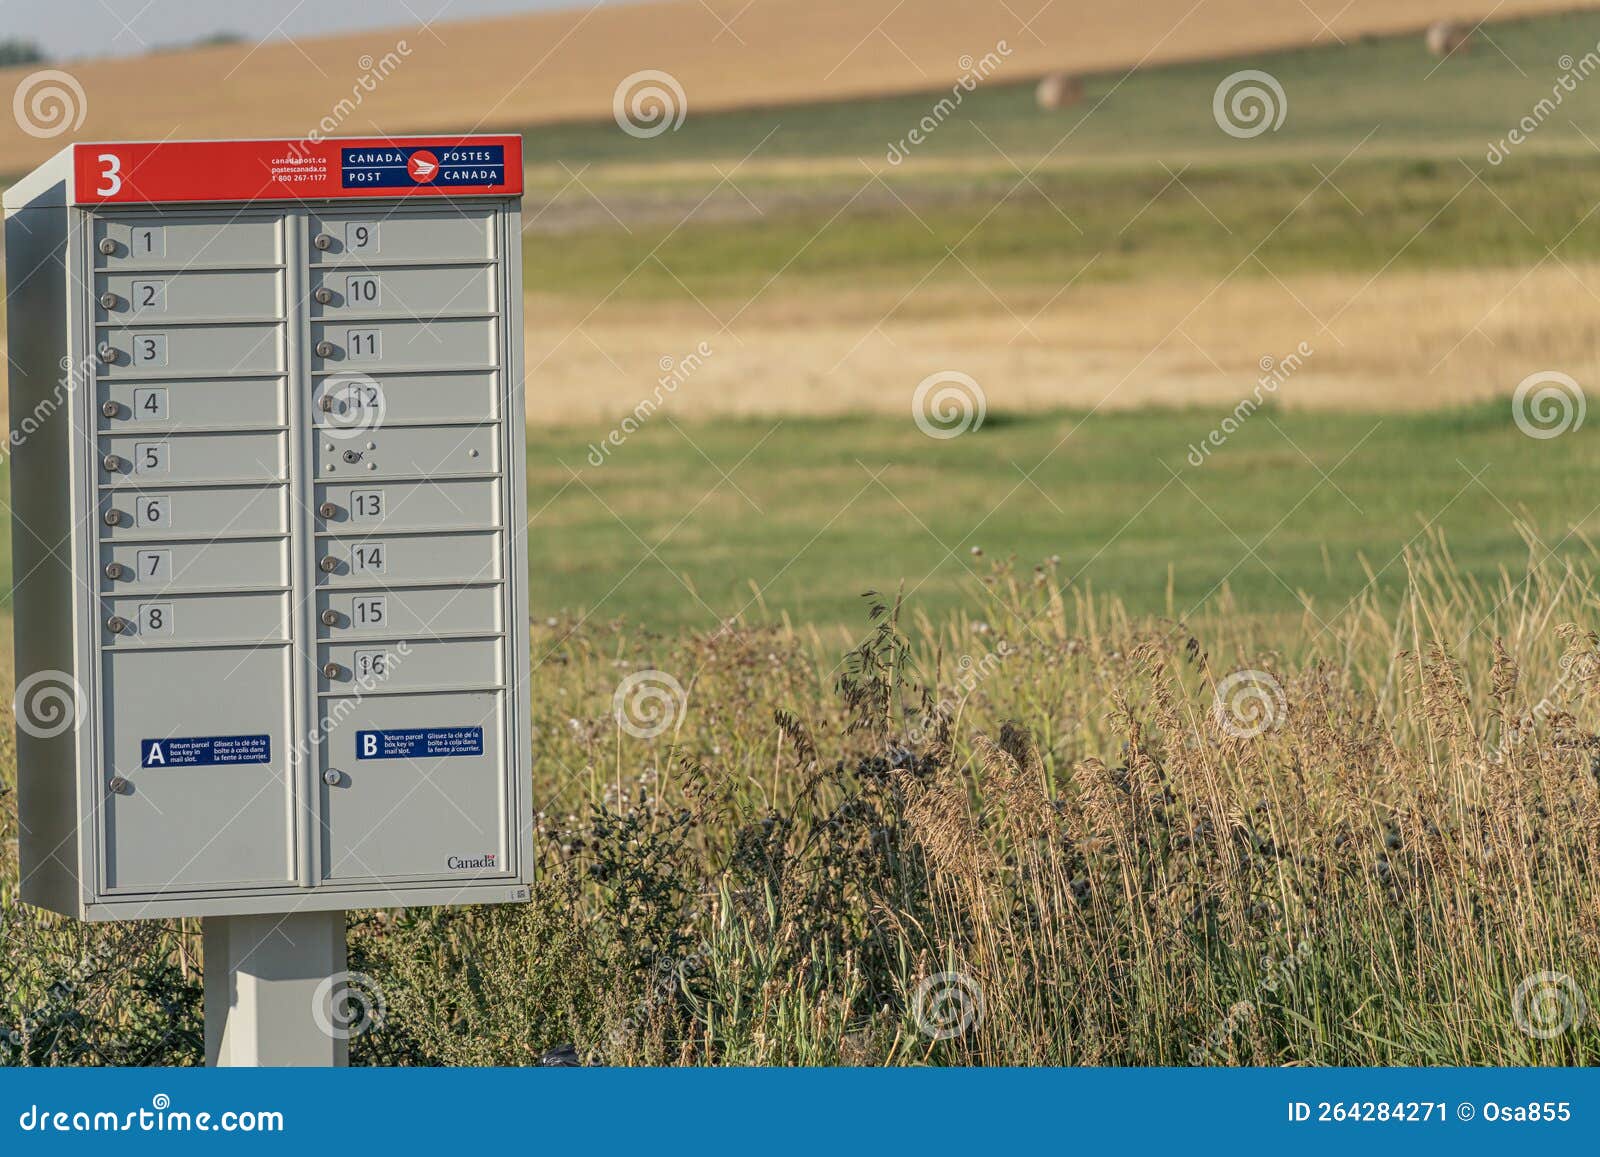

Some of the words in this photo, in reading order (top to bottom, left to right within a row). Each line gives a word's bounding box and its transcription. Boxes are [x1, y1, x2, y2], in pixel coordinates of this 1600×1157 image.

[348, 153, 403, 163] CANADA
[443, 152, 491, 161] POSTES
[96, 154, 122, 197] 3
[271, 166, 327, 174] postescanada.ca
[278, 174, 292, 182] 800
[349, 172, 381, 182] POST
[443, 170, 497, 180] CANADA
[143, 231, 153, 252] 1
[356, 227, 369, 248] 9
[142, 286, 155, 307] 2
[351, 280, 377, 300] 10
[143, 339, 156, 360] 3
[352, 333, 376, 354] 11
[144, 393, 158, 414] 4
[354, 387, 379, 408] 12
[146, 447, 158, 468] 5
[147, 501, 160, 522] 6
[355, 495, 381, 515] 13
[147, 555, 160, 576] 7
[356, 548, 382, 569] 14
[149, 608, 162, 629] 8
[357, 601, 383, 623] 15
[360, 654, 385, 675] 16
[147, 742, 166, 765] A
[191, 741, 210, 750] parcel
[363, 734, 378, 757] B
[396, 741, 408, 749] key
[447, 855, 495, 870] Canada
